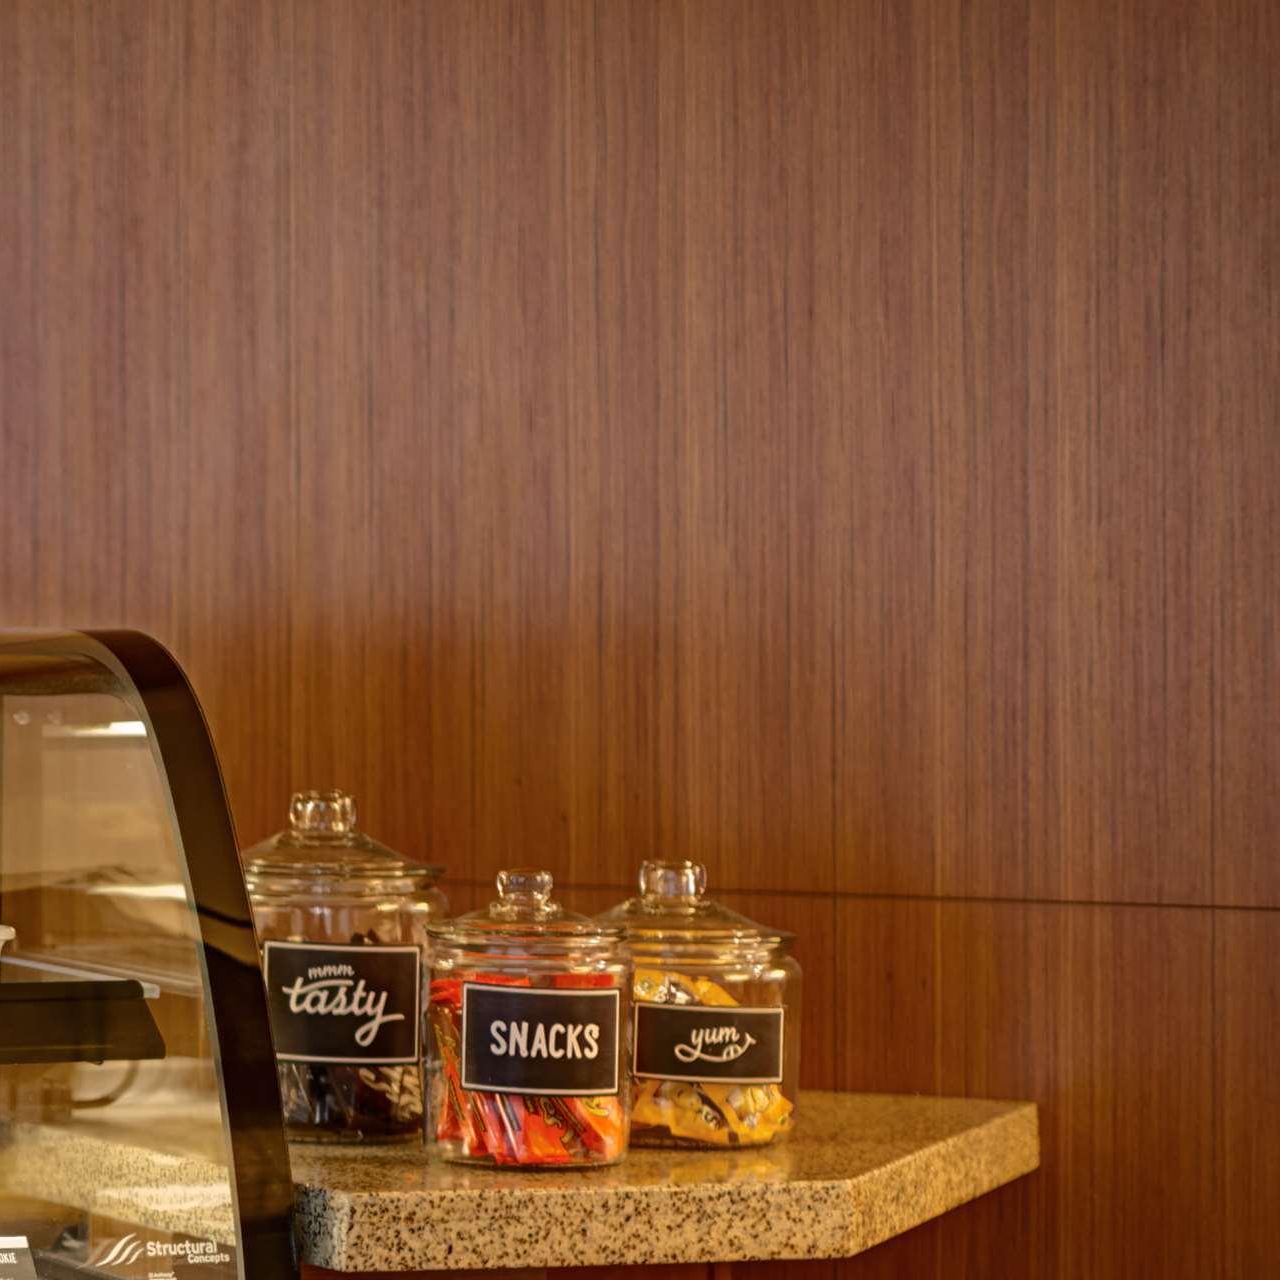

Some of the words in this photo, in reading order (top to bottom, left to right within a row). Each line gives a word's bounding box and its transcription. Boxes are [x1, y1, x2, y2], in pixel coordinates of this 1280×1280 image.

[282, 976, 405, 1047] tasty
[490, 1020, 600, 1059] SNACKS
[146, 1240, 218, 1256] Structural
[187, 1253, 230, 1264] Concepts
